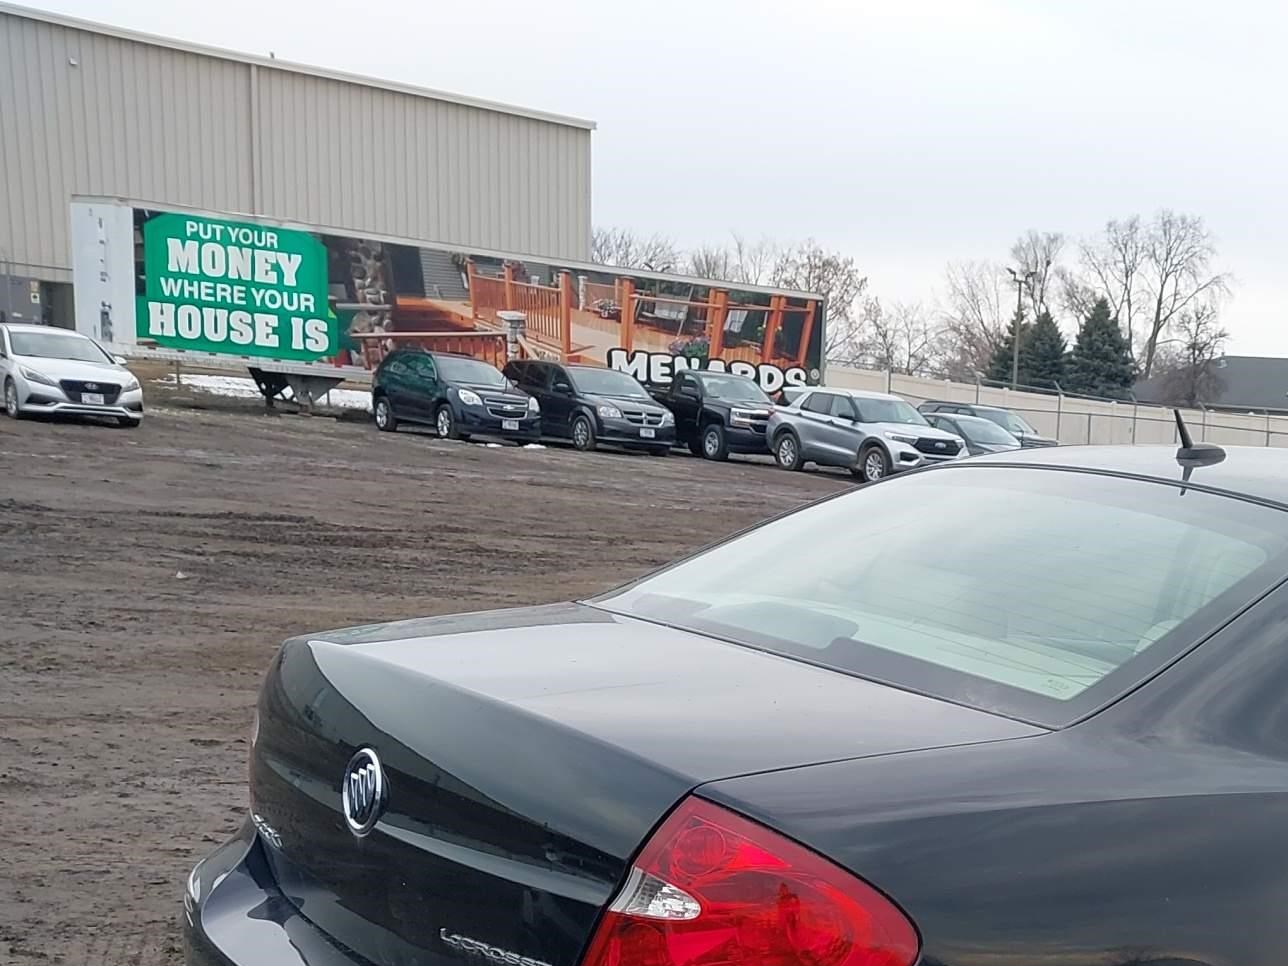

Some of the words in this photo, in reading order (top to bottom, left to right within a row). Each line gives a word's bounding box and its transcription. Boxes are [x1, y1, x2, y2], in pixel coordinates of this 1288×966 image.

[186, 220, 225, 241] PUT
[227, 227, 279, 249] YOUR
[166, 237, 303, 287] MONEY
[159, 277, 247, 305] WHERE
[250, 287, 315, 313] YOUR
[148, 301, 280, 348] HOUSE
[290, 316, 329, 352] IS
